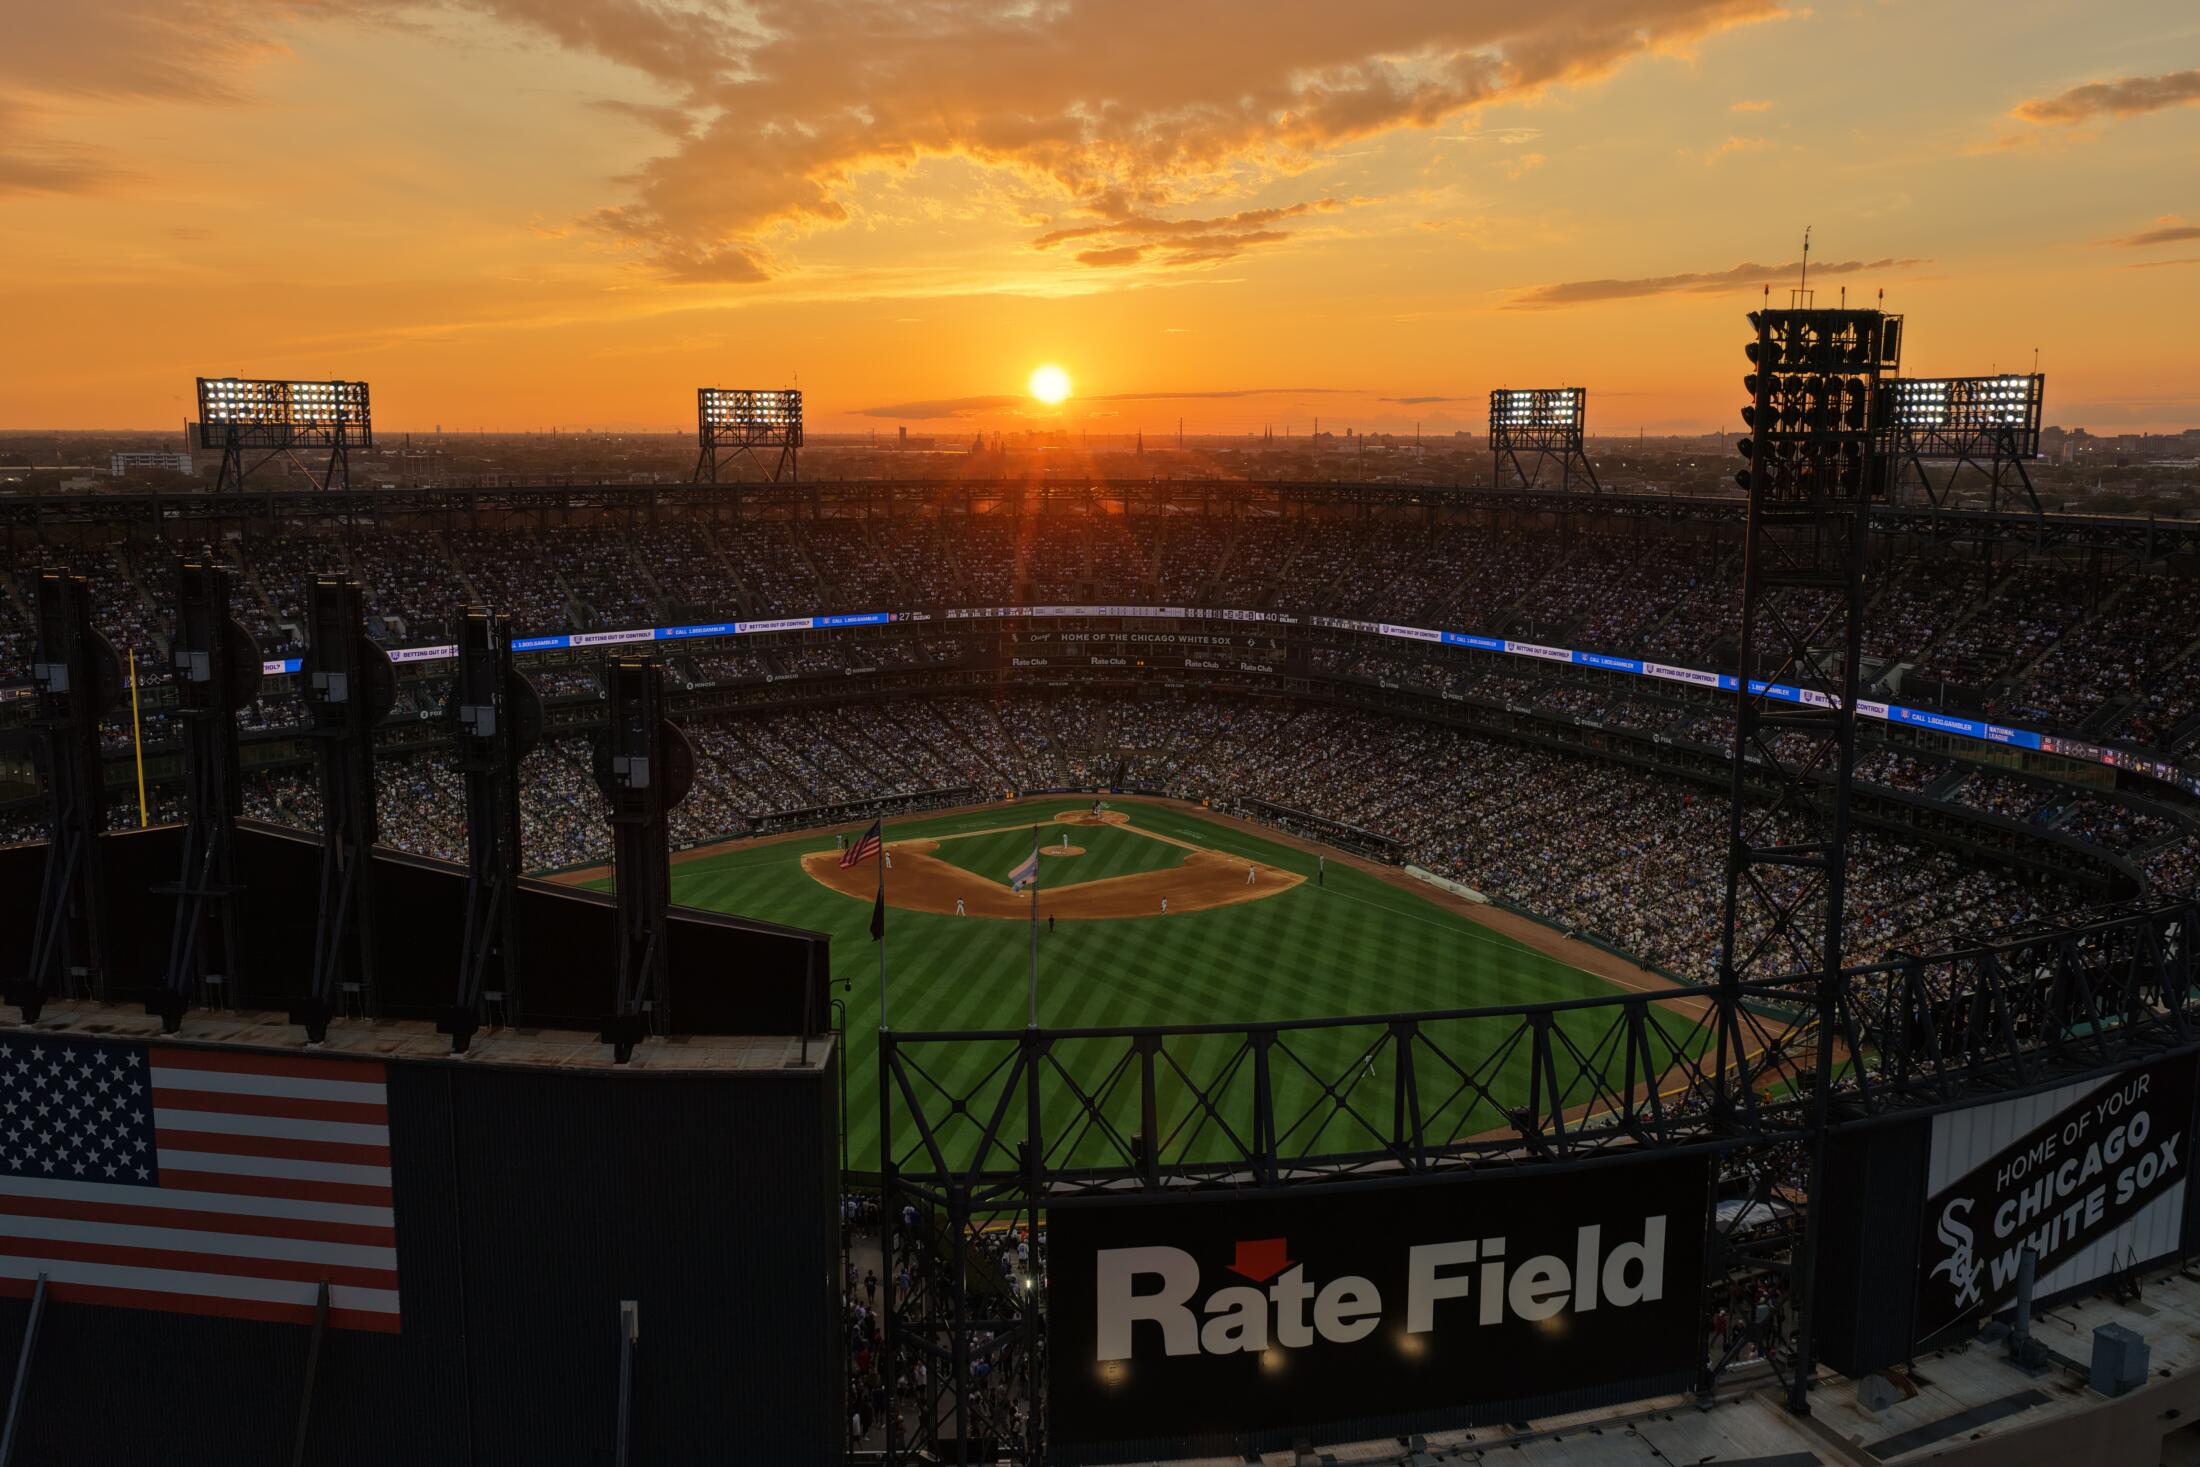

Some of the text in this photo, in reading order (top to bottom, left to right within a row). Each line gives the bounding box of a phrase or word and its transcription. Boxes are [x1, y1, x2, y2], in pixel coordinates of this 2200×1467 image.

[899, 612, 910, 621] 27
[1266, 613, 1277, 621] 40
[1061, 633, 1230, 645] HOME OF THE CHICAGO WHITE SOX
[1012, 657, 1047, 666] Rate Club
[1091, 656, 1126, 665] Rate Club
[1185, 658, 1219, 669] Rate Club
[1241, 662, 1273, 673] Rate Club
[1912, 714, 1925, 722] CALL
[1989, 726, 2015, 737] NATIONAL
[1997, 1073, 2150, 1192] HOME OF YOUR
[1993, 1110, 2150, 1238] CHICAGO
[1990, 1131, 2181, 1291] WHITE SOX
[1096, 1214, 1666, 1361] Rate Field
